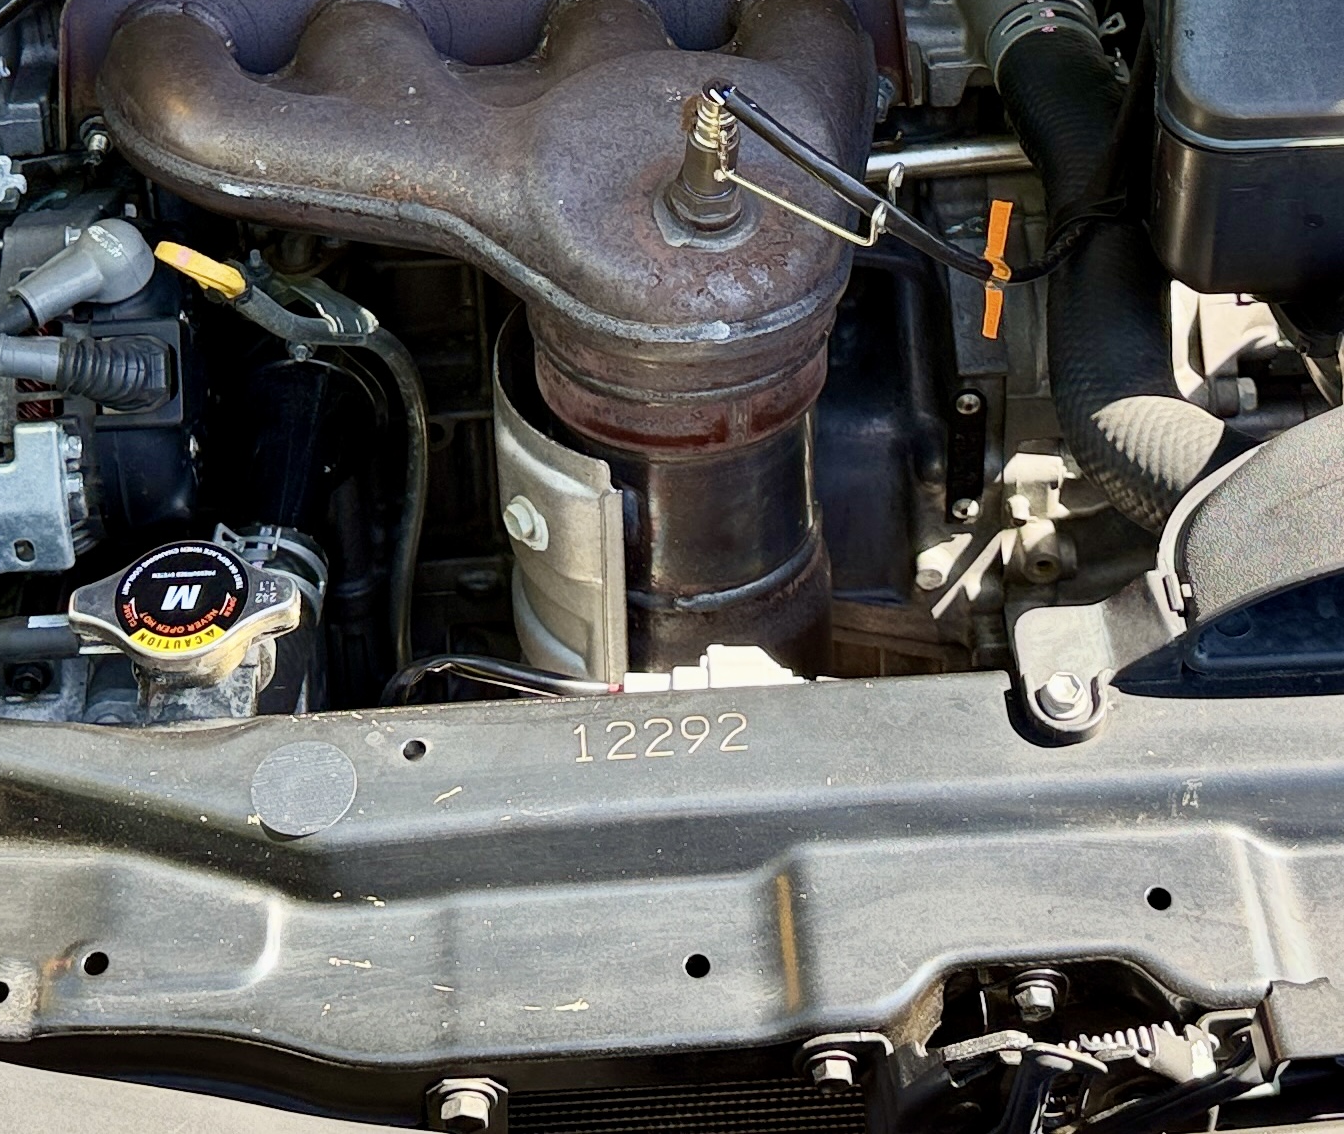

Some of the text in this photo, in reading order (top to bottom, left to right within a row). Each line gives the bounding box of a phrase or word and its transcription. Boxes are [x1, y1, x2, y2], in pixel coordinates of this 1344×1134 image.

[160, 583, 202, 611] M
[136, 631, 203, 650] CAUTION
[572, 711, 749, 763] 12292
